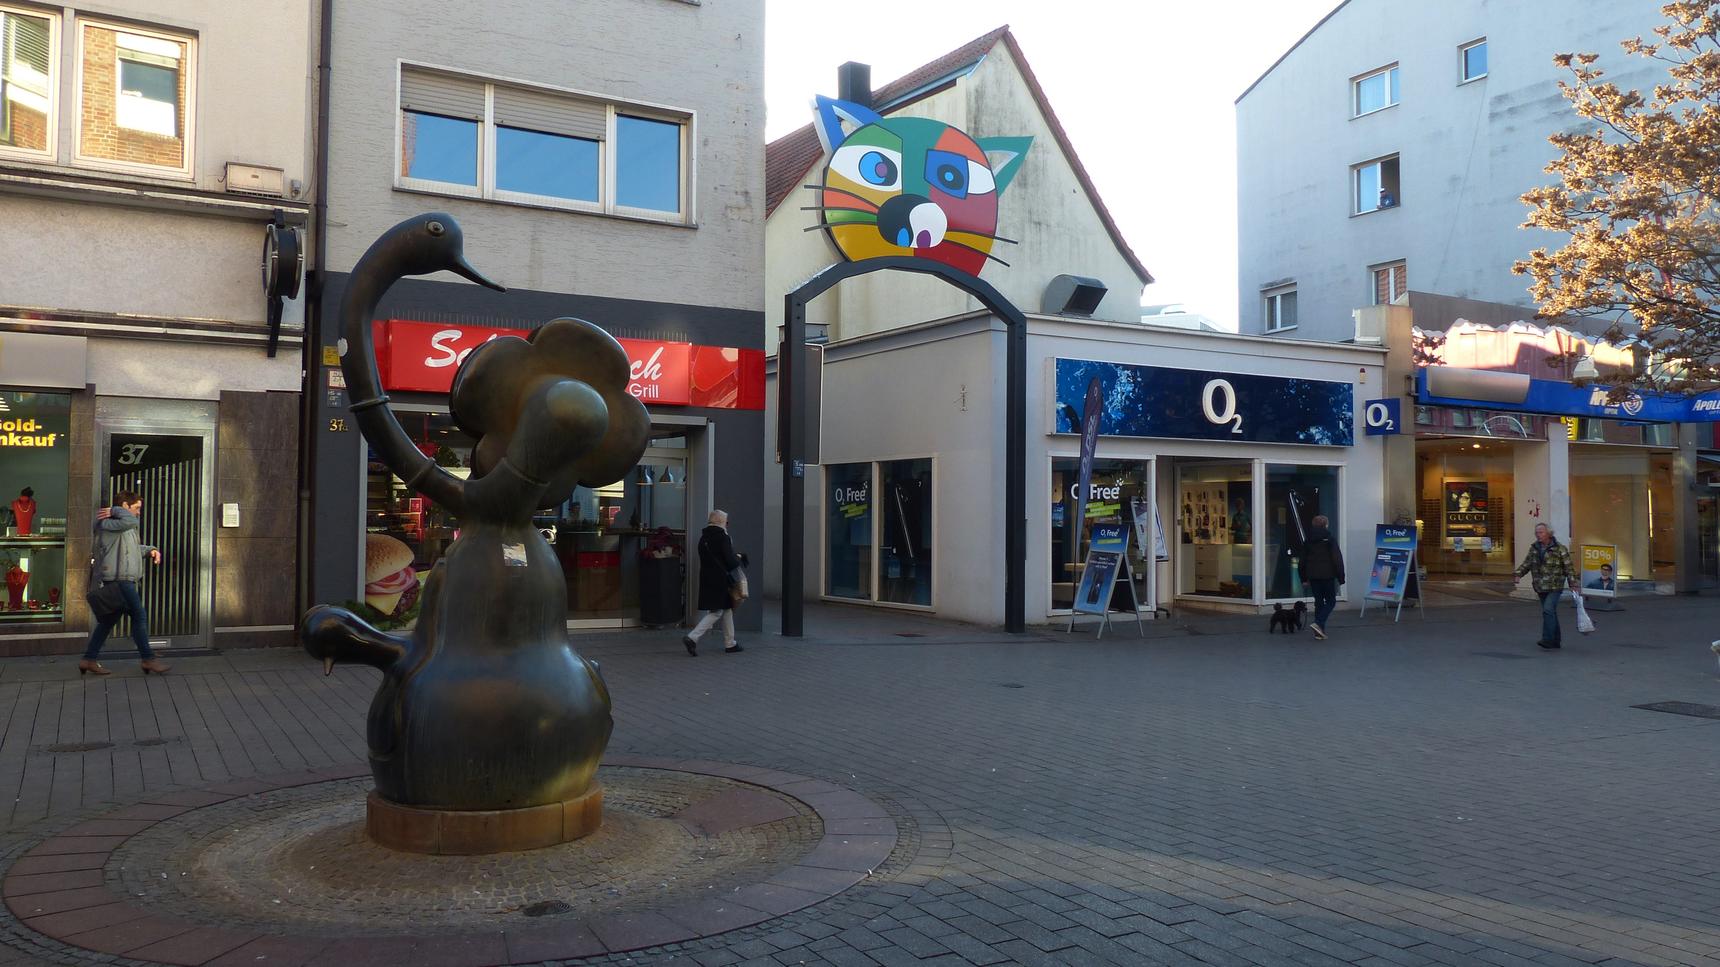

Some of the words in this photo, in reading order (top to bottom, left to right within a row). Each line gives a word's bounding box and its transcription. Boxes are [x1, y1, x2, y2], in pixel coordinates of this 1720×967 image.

[629, 383, 659, 398] Grill
[1202, 378, 1243, 434] O2
[1366, 402, 1394, 431] O2
[0, 418, 42, 432] old-
[118, 443, 150, 465] 37
[846, 487, 866, 502] Free
[1089, 483, 1120, 500] Free
[1106, 529, 1119, 537] Free
[1393, 529, 1406, 537] Free
[1585, 549, 1612, 560] 50%
